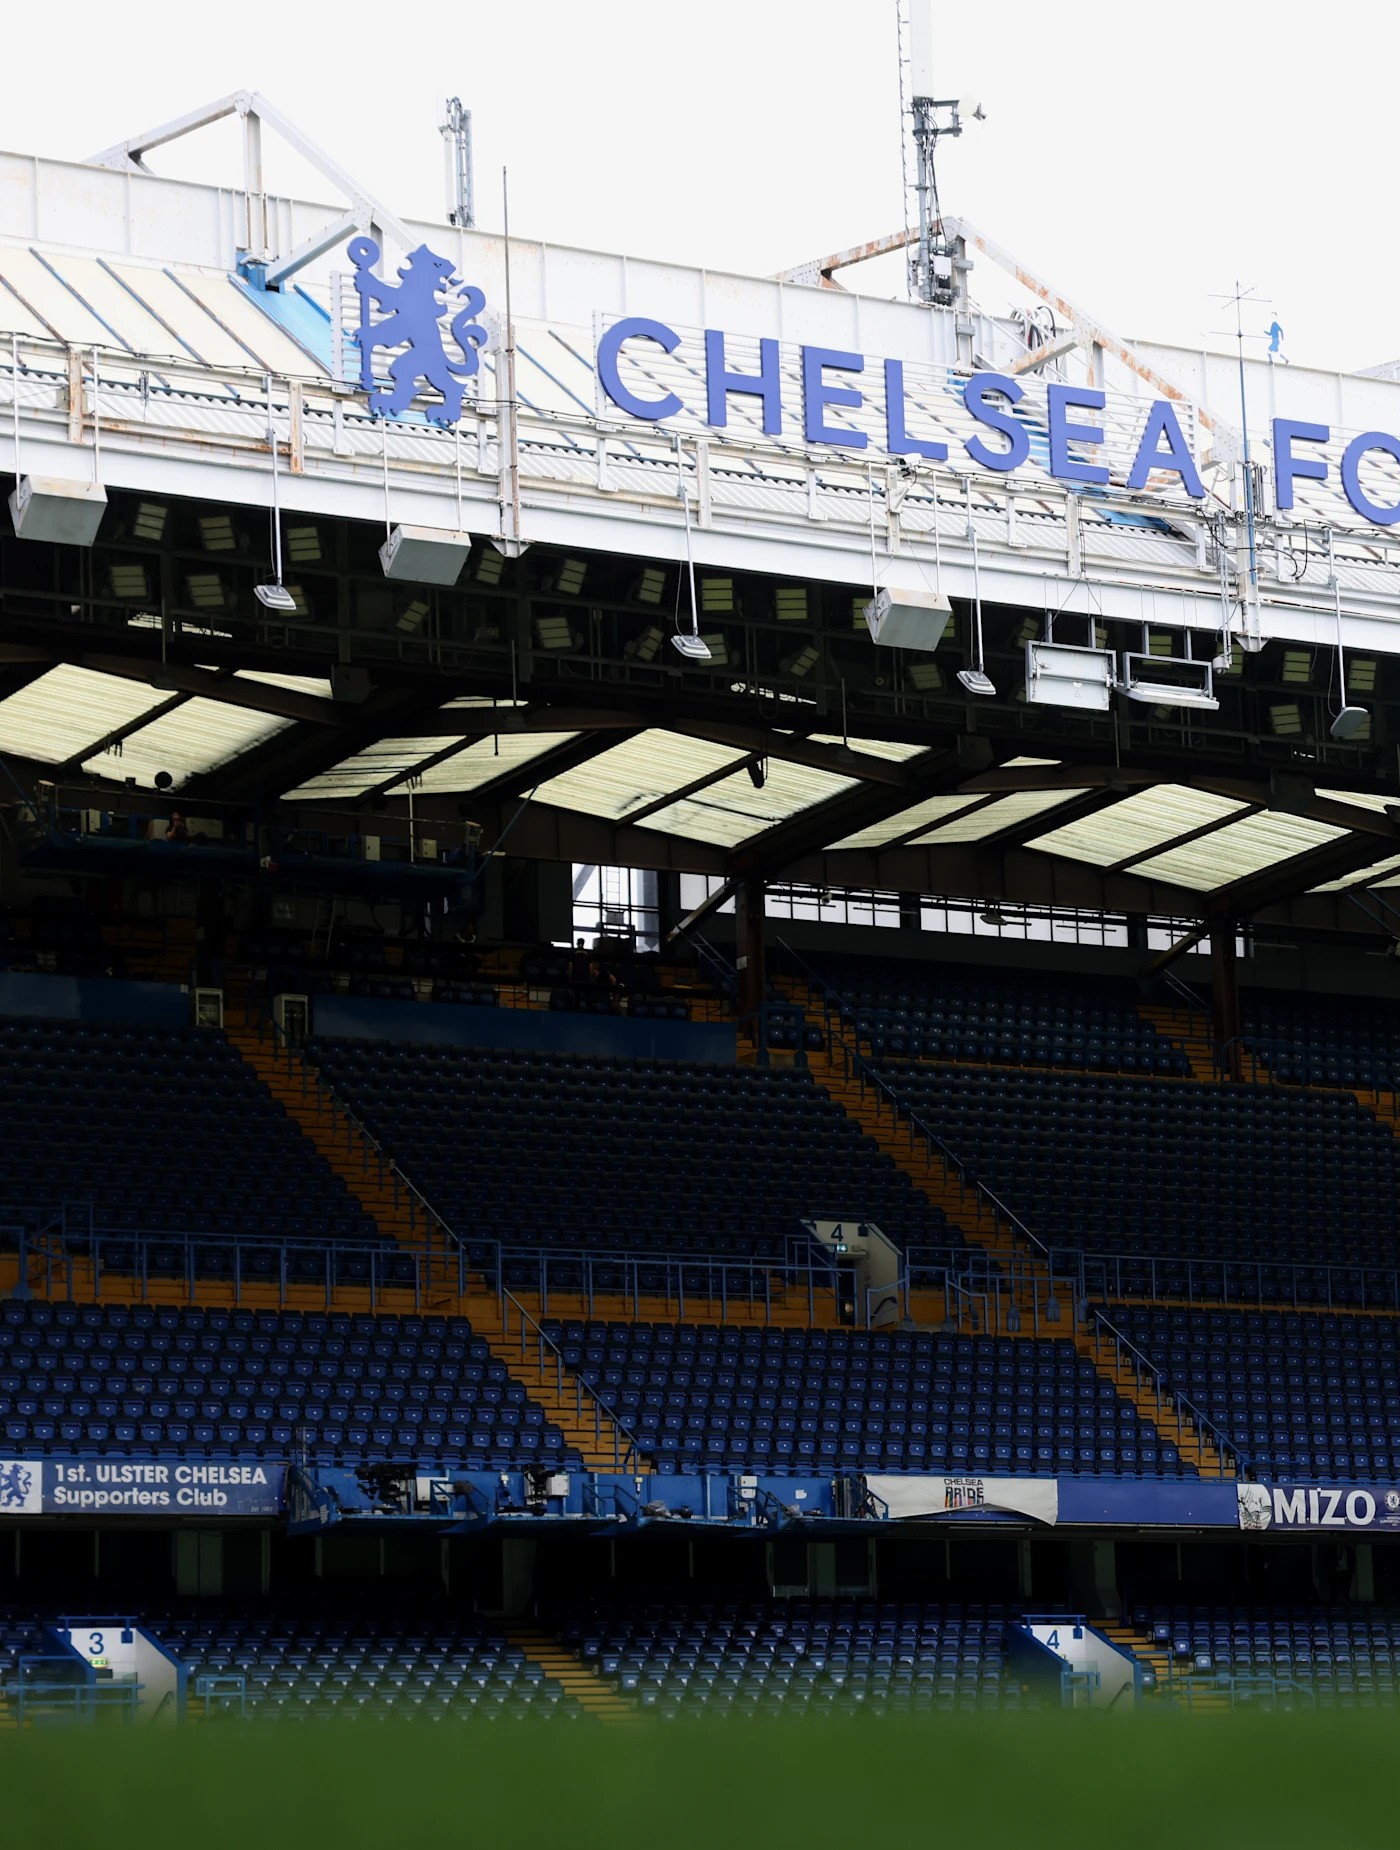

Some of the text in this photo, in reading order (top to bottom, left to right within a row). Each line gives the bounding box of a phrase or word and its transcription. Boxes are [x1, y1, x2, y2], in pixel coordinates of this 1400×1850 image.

[597, 317, 1206, 498] CHELSEA
[831, 1224, 844, 1241] 4
[55, 1464, 267, 1485] 1st. ULSTER CHELSEA
[944, 1478, 984, 1486] CHELSEA
[53, 1487, 228, 1508] Supporters Club
[1273, 1488, 1376, 1526] MIZO
[89, 1632, 104, 1655] 3
[1047, 1629, 1059, 1649] 4
